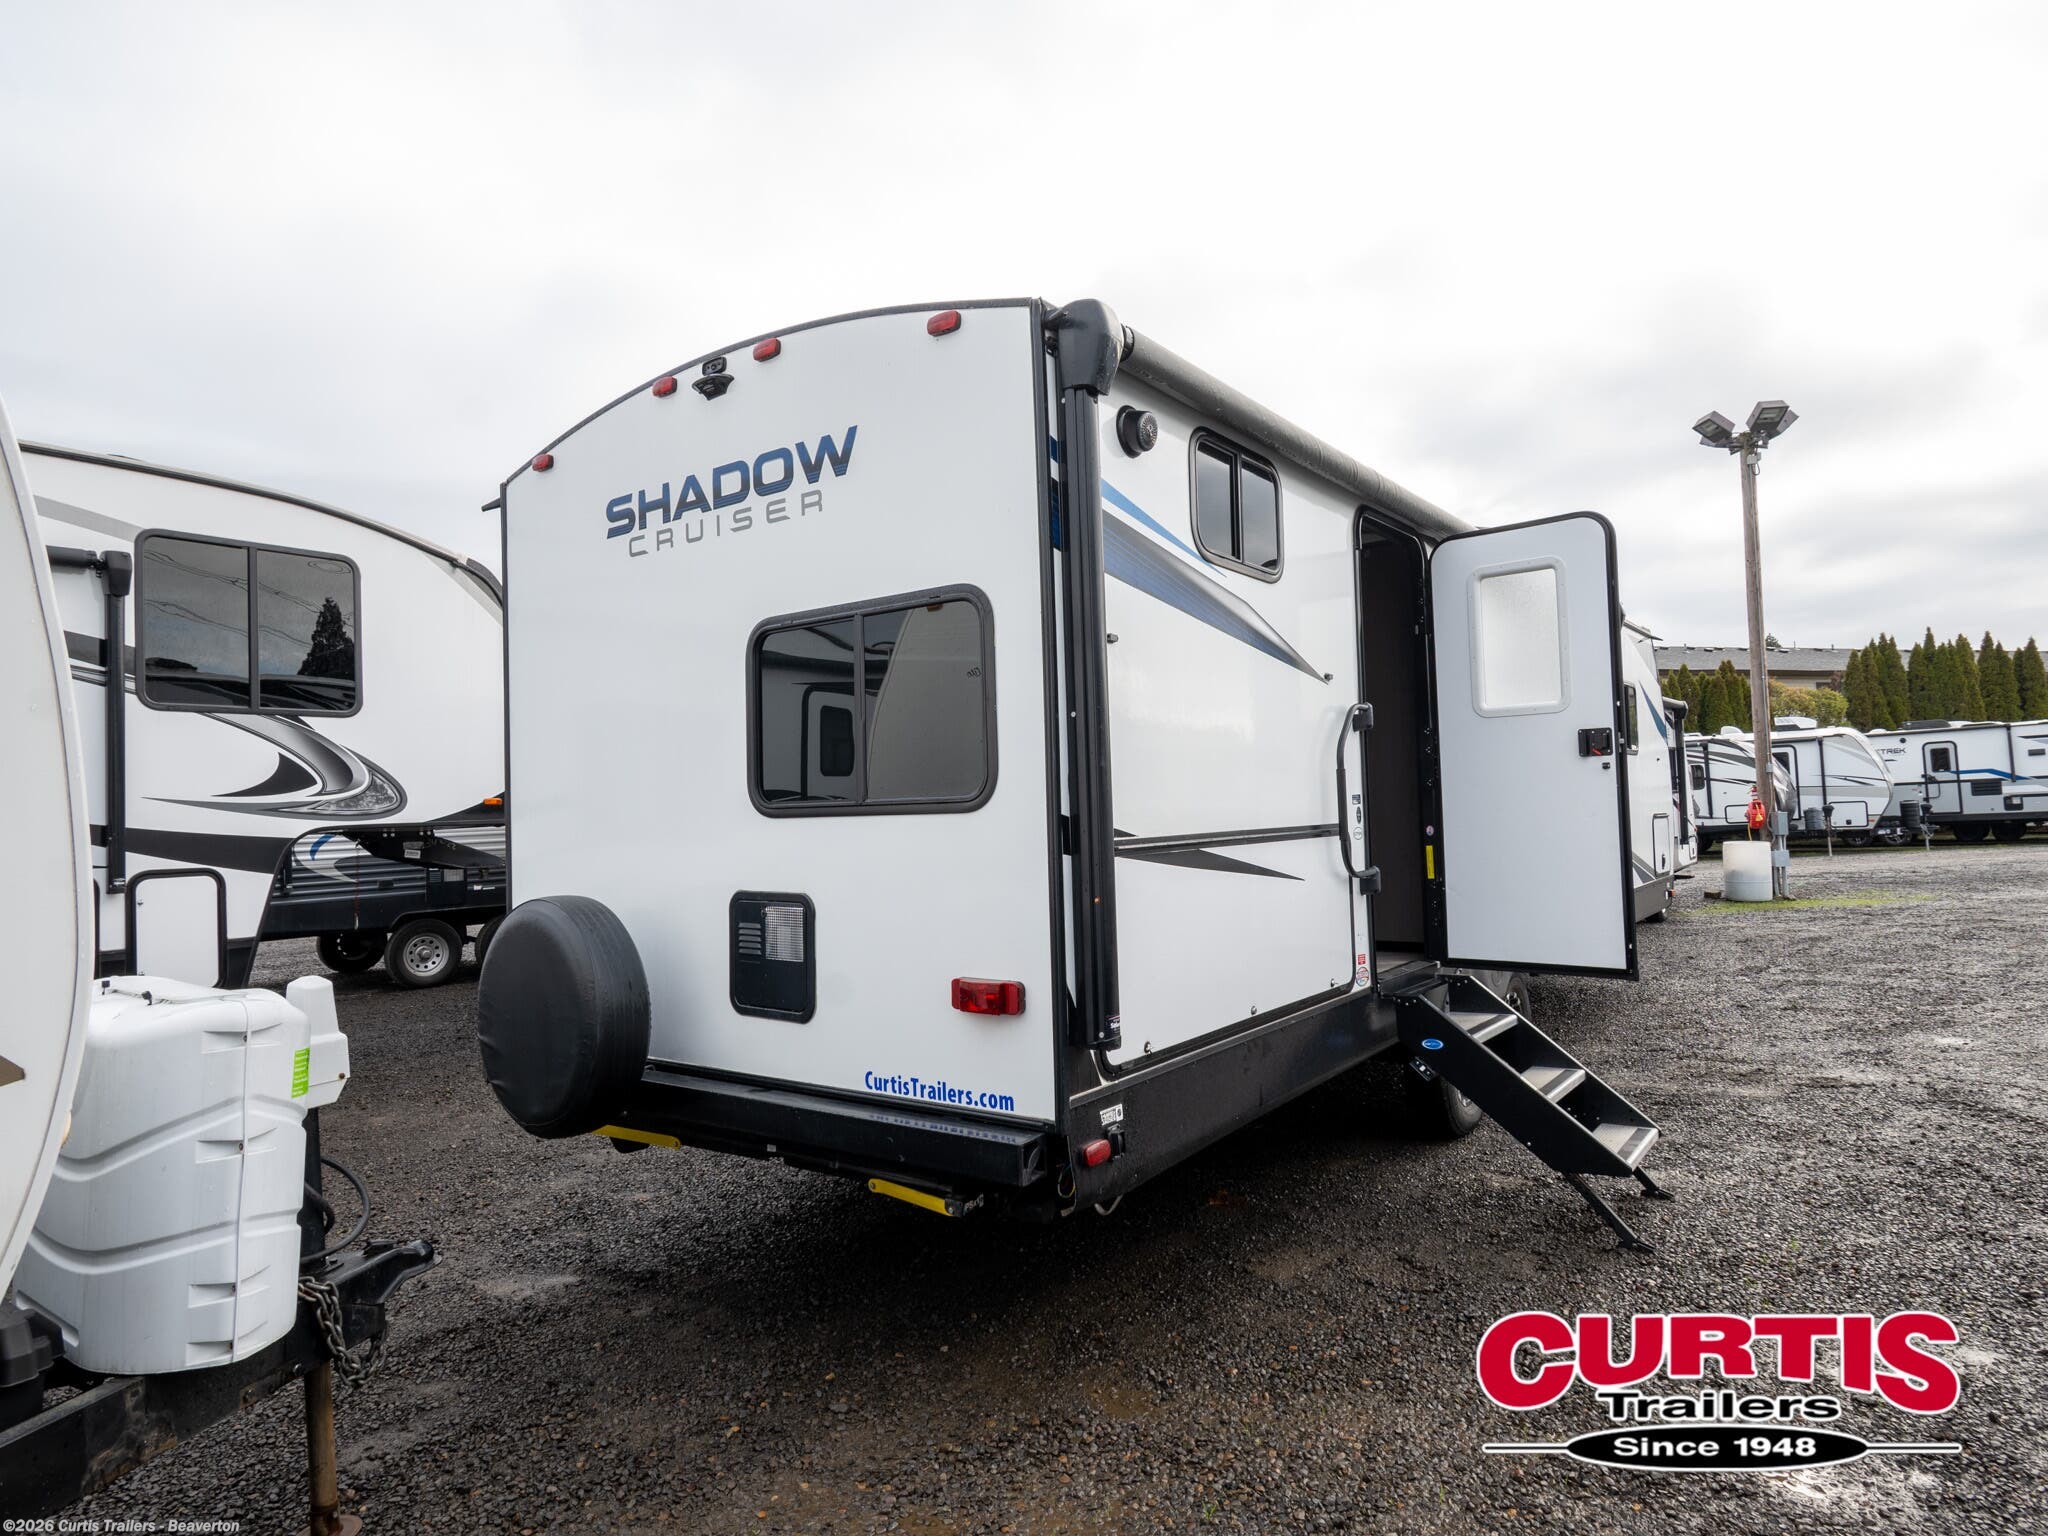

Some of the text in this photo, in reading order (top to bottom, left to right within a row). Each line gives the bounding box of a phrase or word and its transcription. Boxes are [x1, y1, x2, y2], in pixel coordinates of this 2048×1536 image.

[606, 425, 858, 539] SHADOW
[629, 489, 823, 557] CRUISER
[865, 1071, 1014, 1111] CurtisTrailers.com
